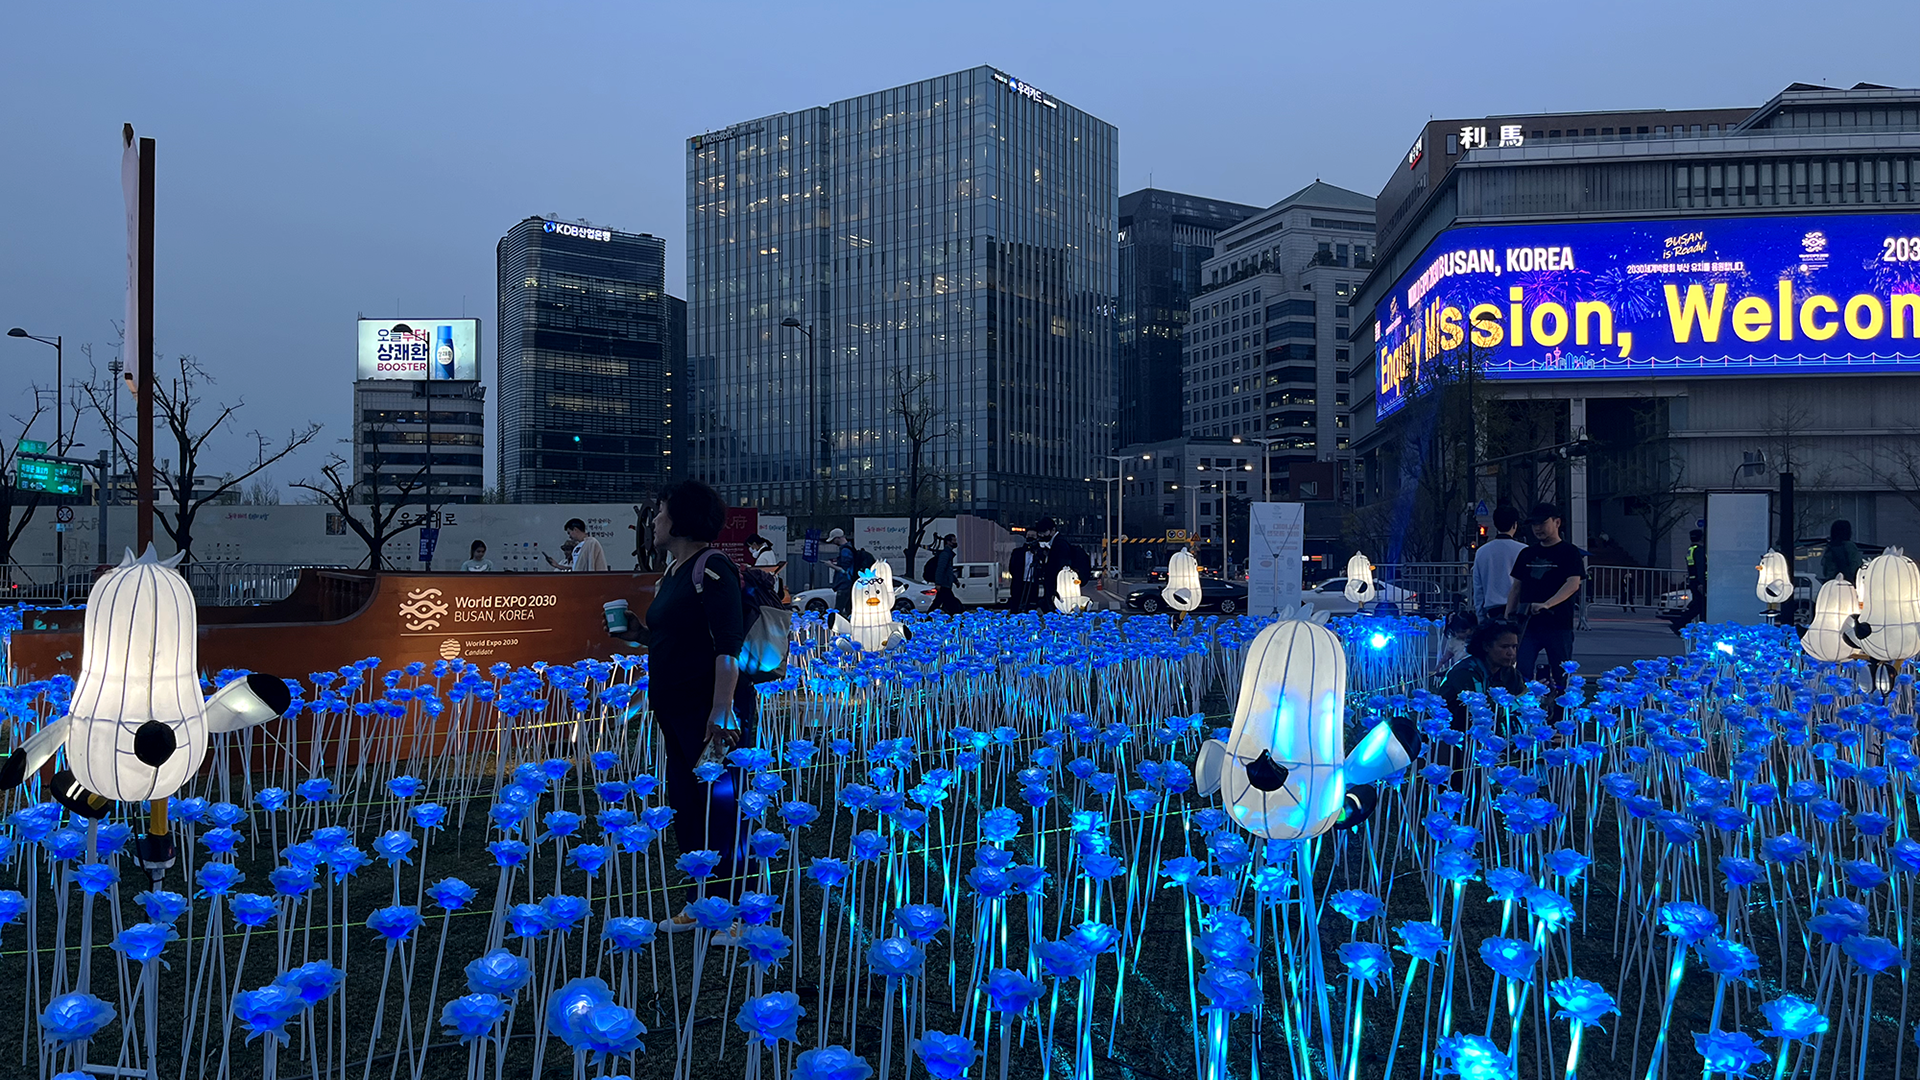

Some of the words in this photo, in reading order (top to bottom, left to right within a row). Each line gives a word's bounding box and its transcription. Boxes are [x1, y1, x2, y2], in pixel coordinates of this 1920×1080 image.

[1017, 81, 1043, 104] 우리카드
[701, 130, 734, 146] Microsoft
[1460, 125, 1524, 149] 利馬
[556, 223, 611, 242] KDB산업은행
[1664, 231, 1703, 248] BUSAN
[1438, 248, 1502, 278] BUSAN,
[1506, 246, 1574, 272] KOREA
[1662, 250, 1672, 259] is
[1381, 324, 1422, 397] Enquiry
[1425, 287, 1632, 362] Mission,
[377, 343, 428, 361] 상쾌환
[377, 362, 427, 371] BOOSTER
[455, 596, 492, 609] World
[494, 596, 527, 608] EXPO
[528, 595, 557, 607] 2030
[454, 610, 496, 623] BUSAN,
[499, 609, 535, 621] KOREA
[465, 639, 486, 647] World
[486, 639, 502, 648] Expo
[502, 638, 519, 646] 2030
[464, 648, 494, 656] Candidate
